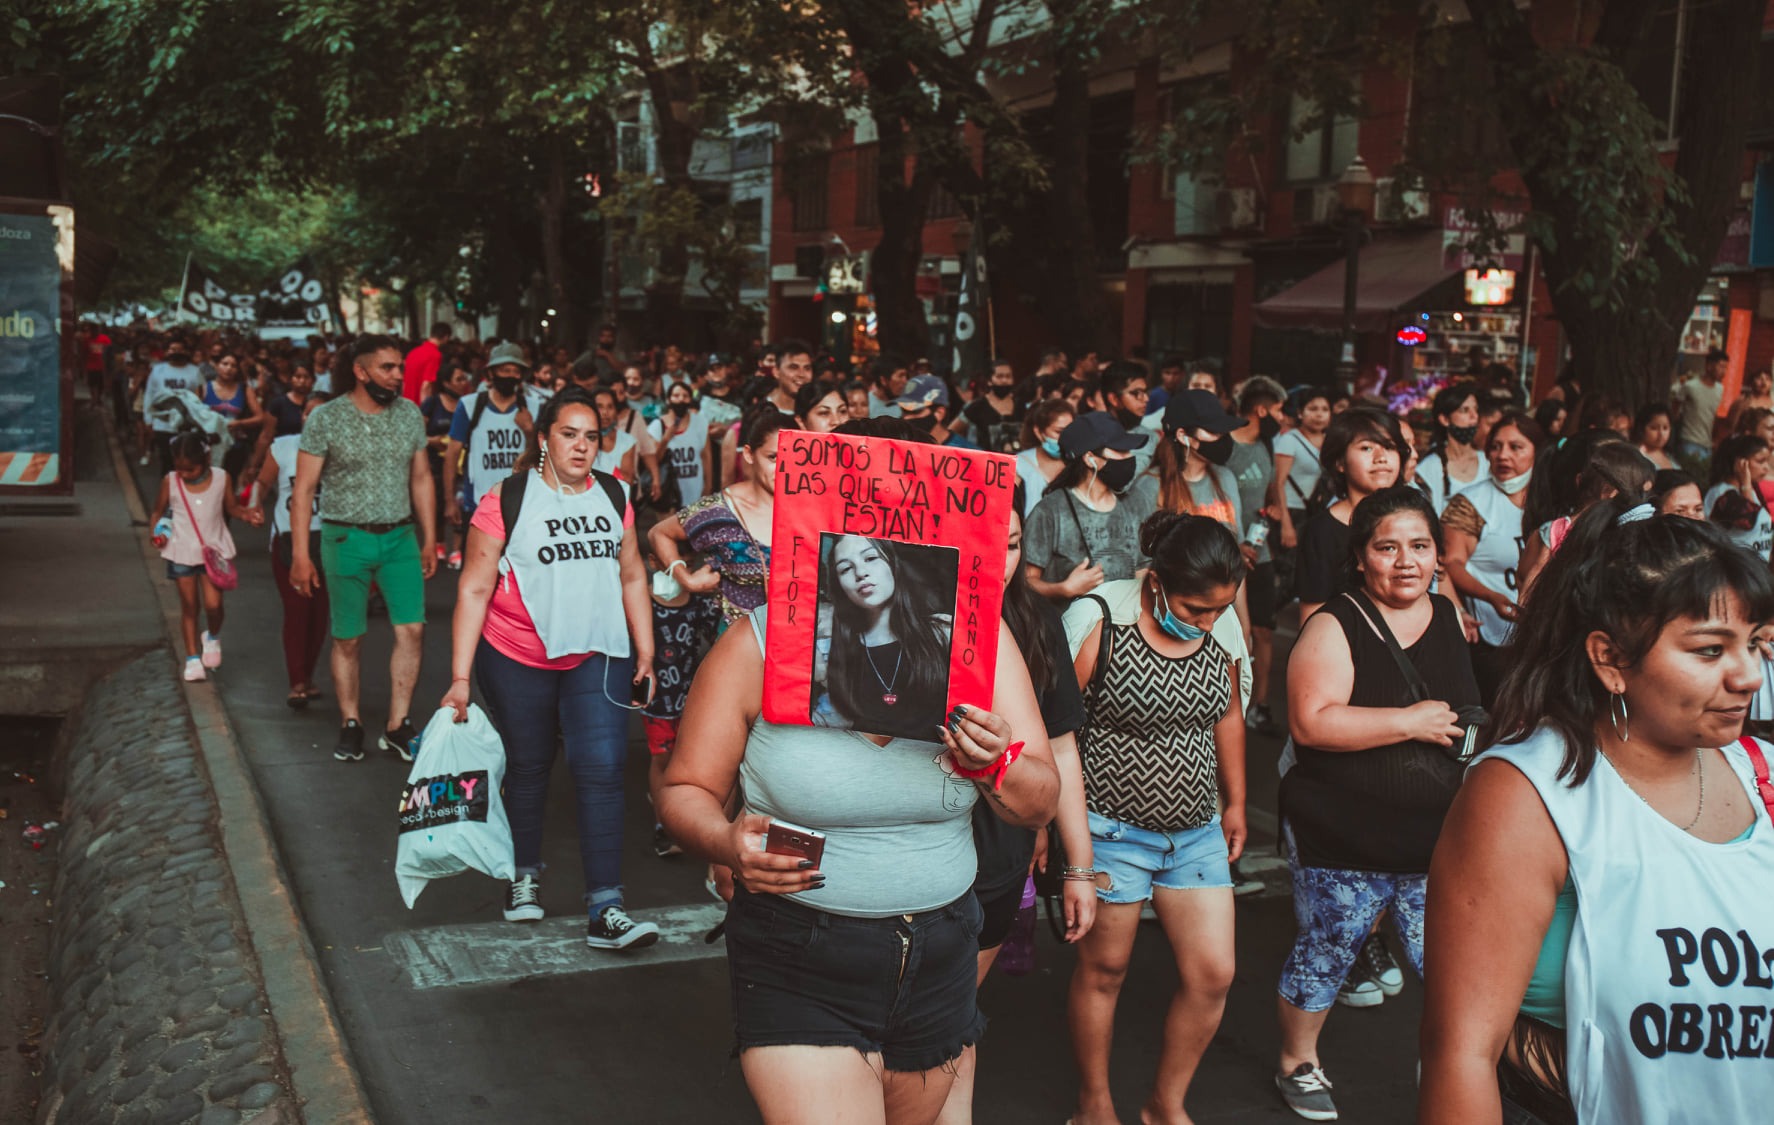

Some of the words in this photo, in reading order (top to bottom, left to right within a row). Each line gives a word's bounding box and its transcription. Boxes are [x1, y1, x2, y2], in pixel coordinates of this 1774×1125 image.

[488, 428, 521, 449] POLO
[888, 447, 917, 476] LA
[930, 452, 972, 482] VOZ
[985, 459, 1009, 489] DE
[784, 471, 826, 496] LAS
[838, 473, 883, 504] QUE
[898, 478, 929, 510] YA
[946, 486, 986, 517] NO
[544, 515, 611, 537] POLO
[787, 536, 804, 626] FLOR
[962, 555, 982, 667] ROMANO
[658, 665, 680, 689] 30
[1656, 927, 1774, 990] POL
[1629, 1002, 1774, 1060] OBRE
